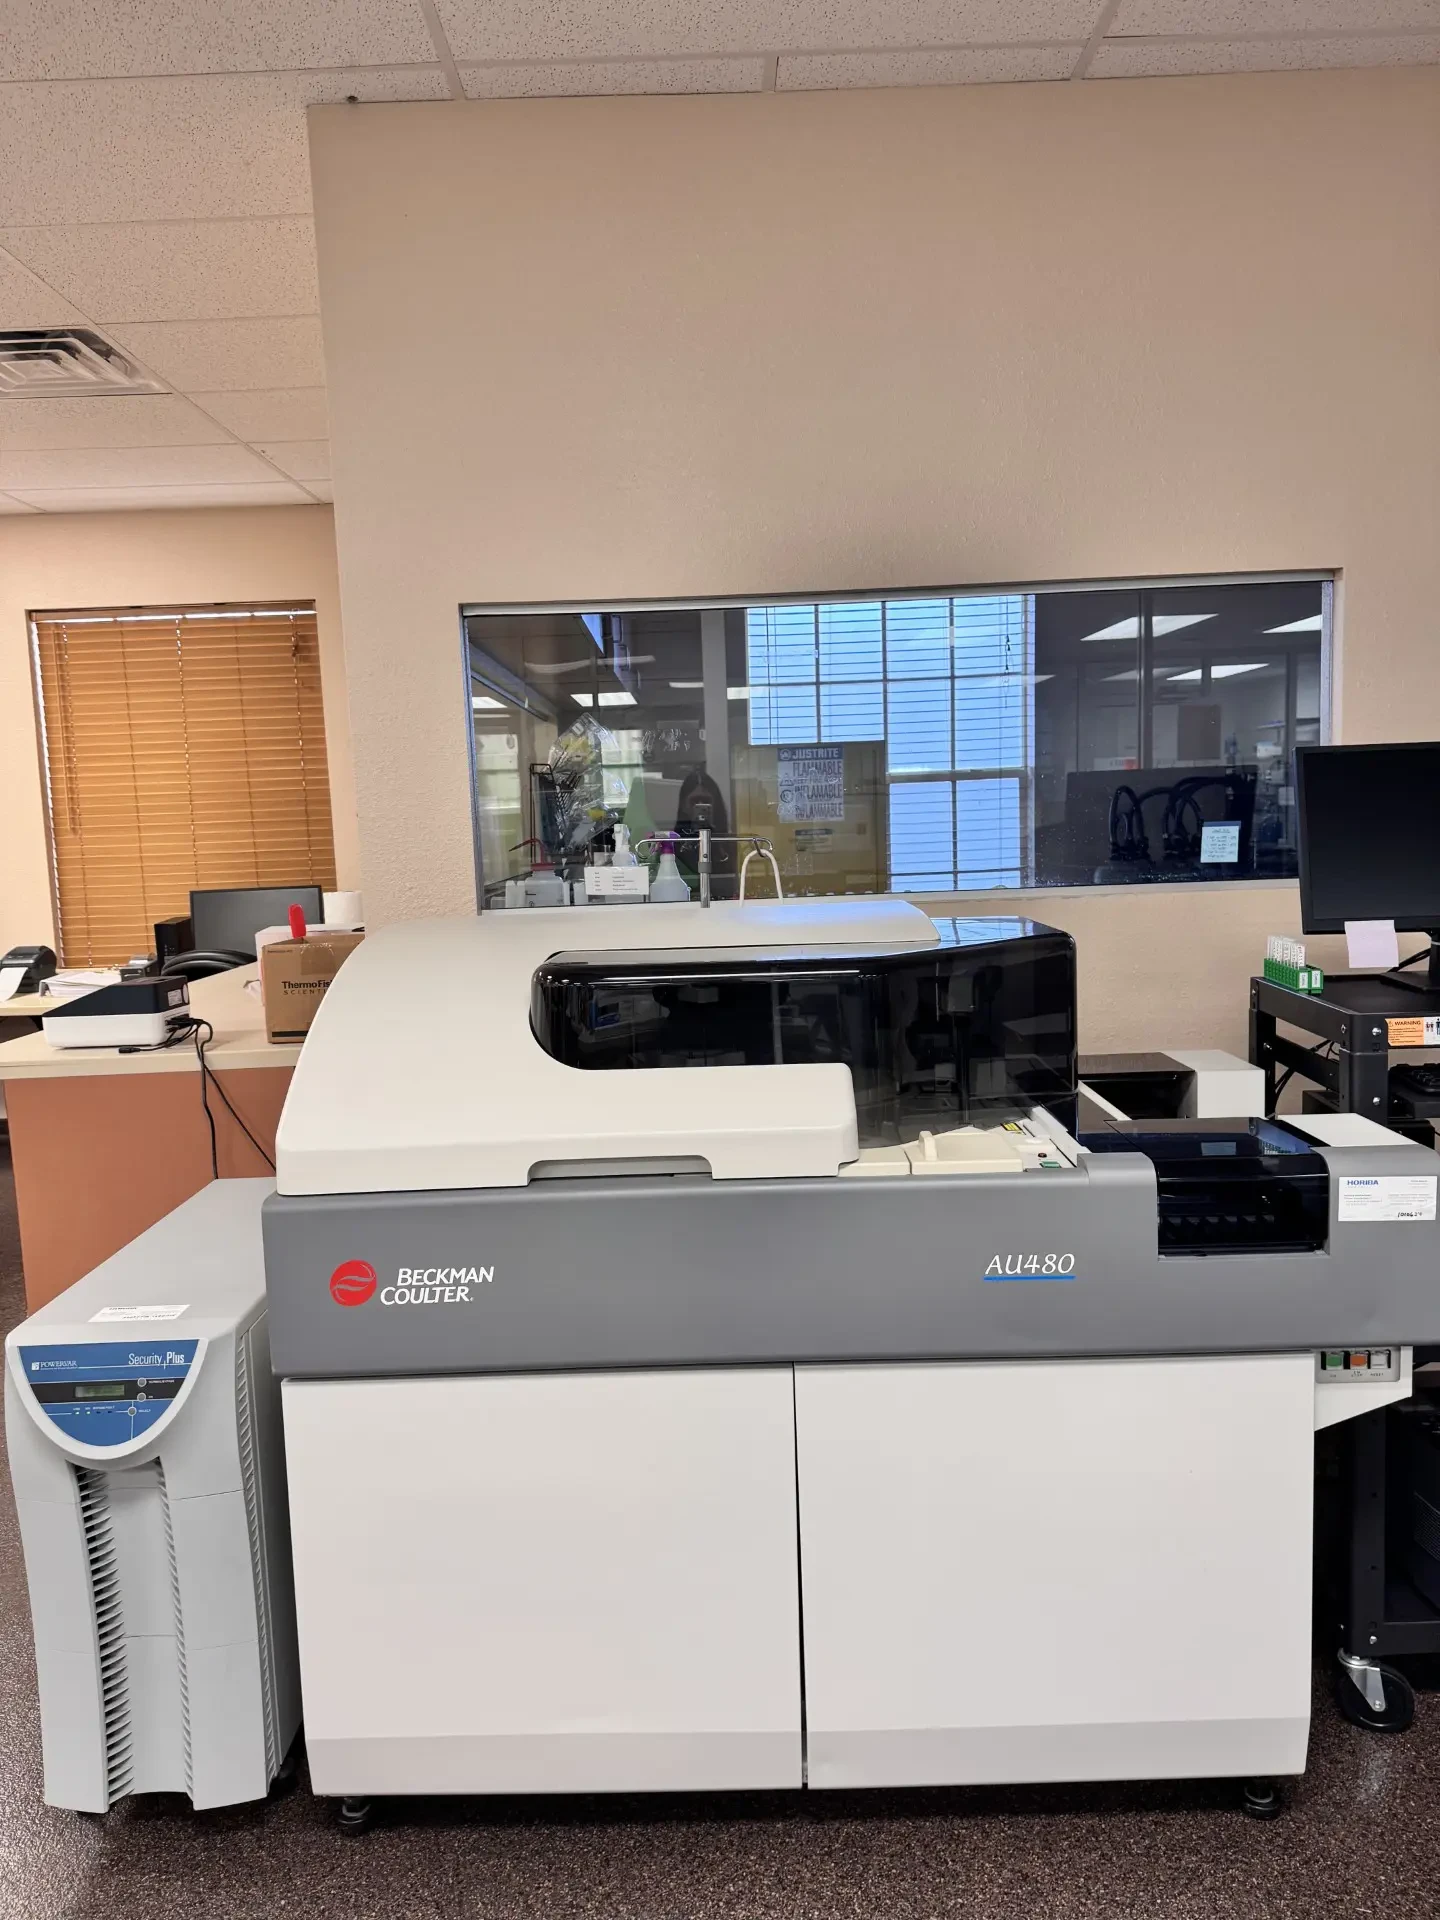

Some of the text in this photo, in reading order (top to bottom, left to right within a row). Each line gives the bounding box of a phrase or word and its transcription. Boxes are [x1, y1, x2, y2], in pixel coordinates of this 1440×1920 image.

[792, 748, 839, 759] JUSTRITE
[793, 761, 843, 776] FLAMMABLE
[985, 1253, 1075, 1275] AU480
[397, 1266, 495, 1287] BECKMAN
[128, 1351, 185, 1366] Security Plus
